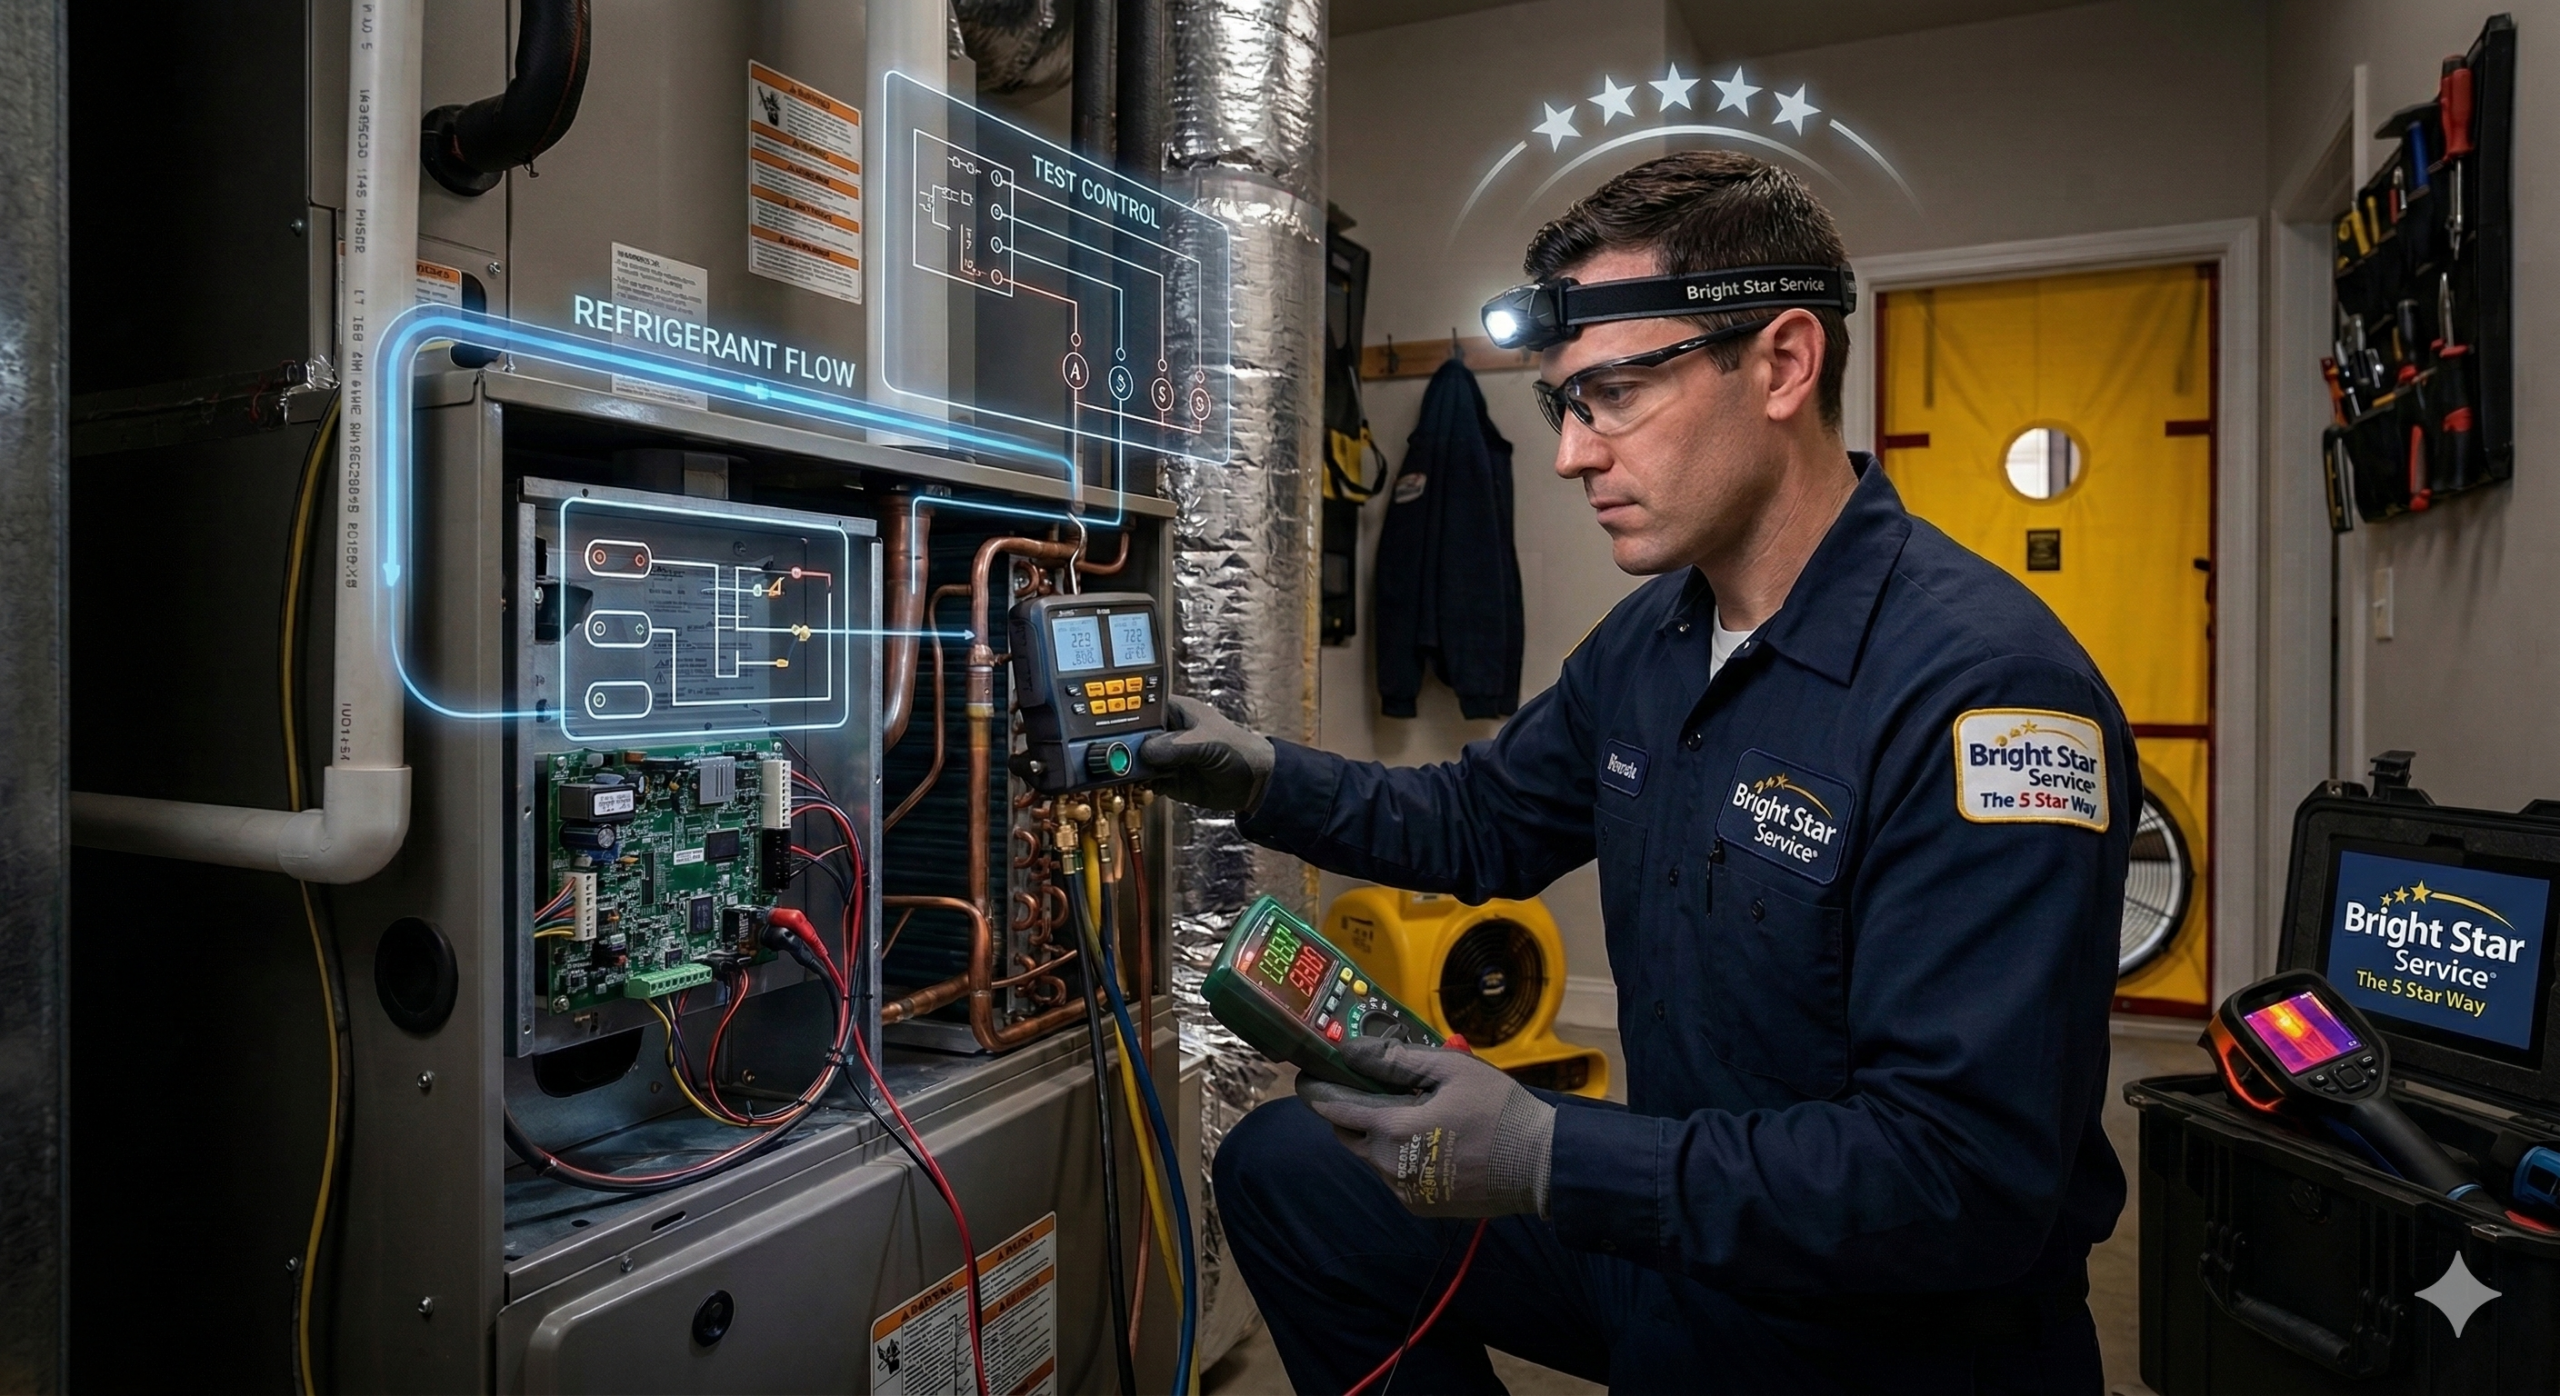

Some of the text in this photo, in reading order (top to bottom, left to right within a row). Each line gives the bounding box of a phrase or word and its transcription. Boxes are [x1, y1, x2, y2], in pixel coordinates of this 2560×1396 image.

[1686, 277, 1825, 301] Bright Star Service
[1969, 742, 2098, 775] Bright Star
[1732, 782, 1837, 845] Bright Star
[1980, 792, 2097, 819] The 5 Star Way
[2344, 901, 2526, 964] Bright Star
[2356, 969, 2486, 1018] The 5 Star Way
